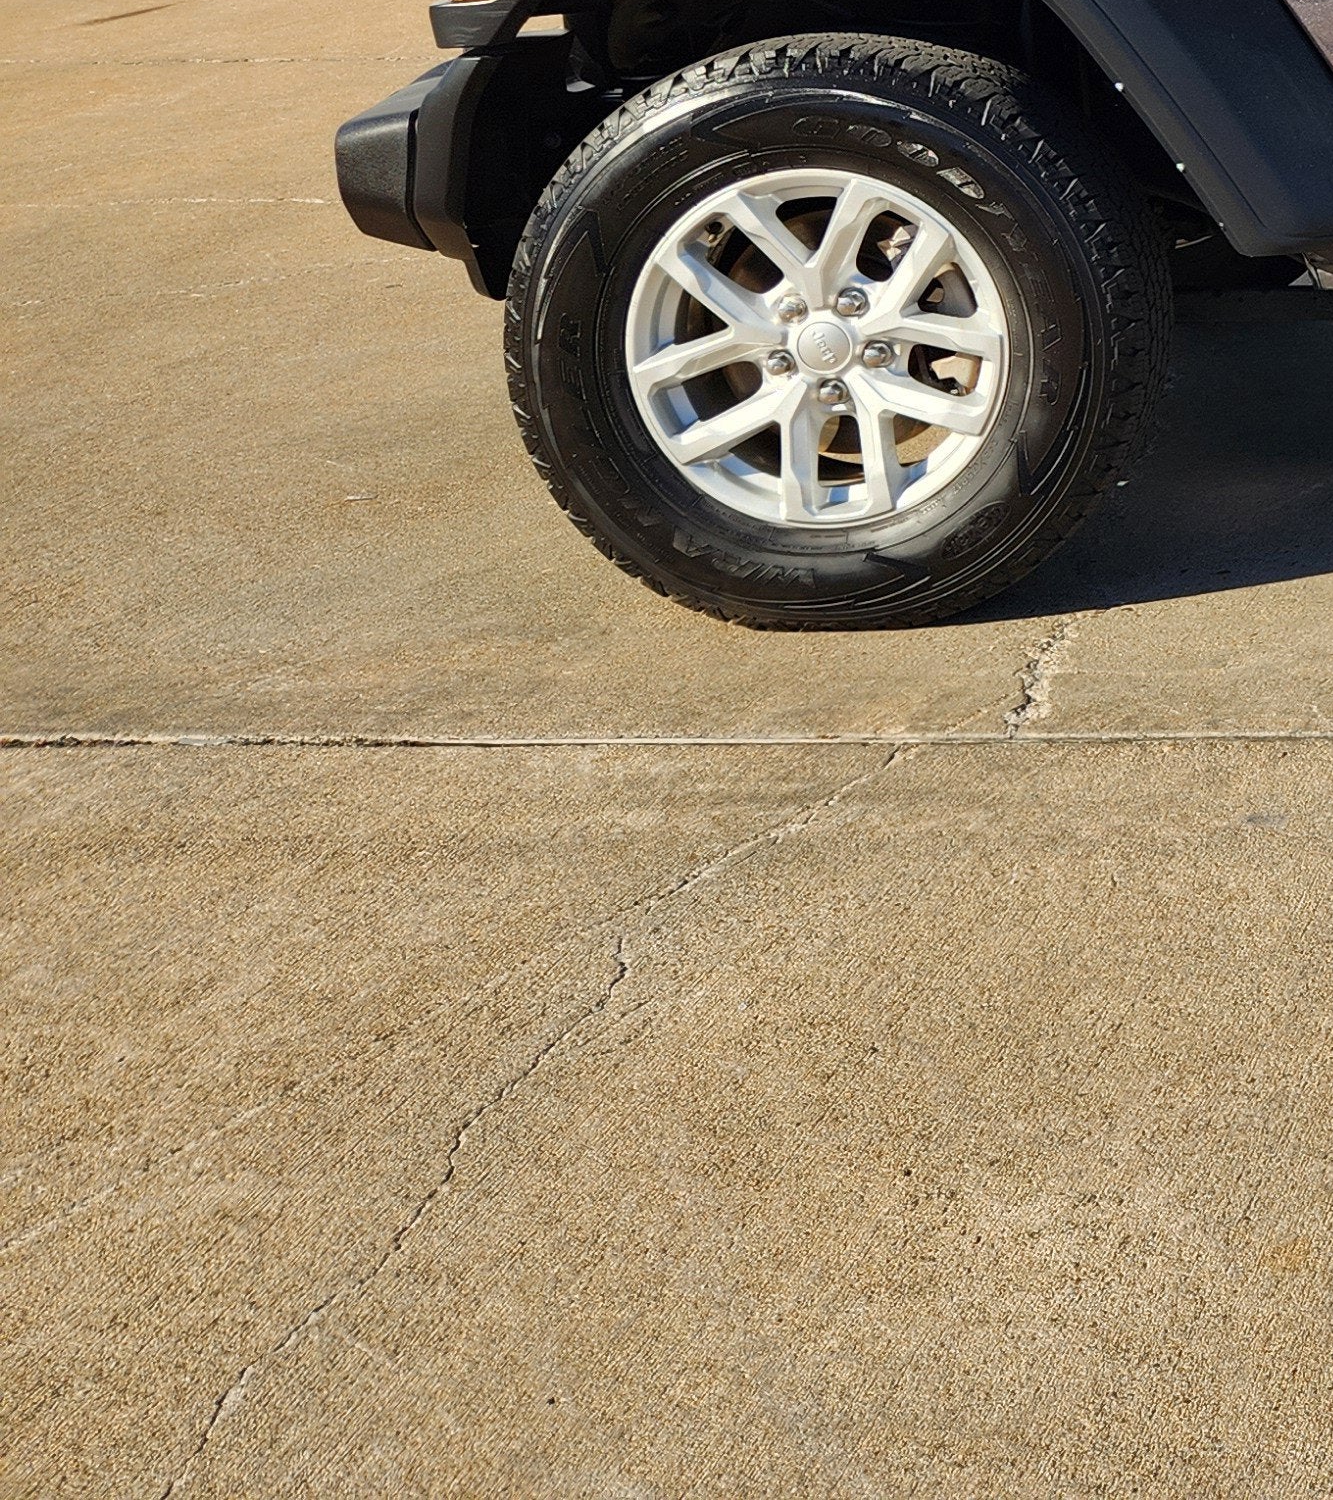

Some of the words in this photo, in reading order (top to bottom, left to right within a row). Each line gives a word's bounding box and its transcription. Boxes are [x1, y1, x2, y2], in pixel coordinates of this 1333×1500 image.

[790, 114, 1061, 407] GOODYEAR
[811, 330, 837, 364] Jeep
[557, 311, 817, 590] WRANGLER
